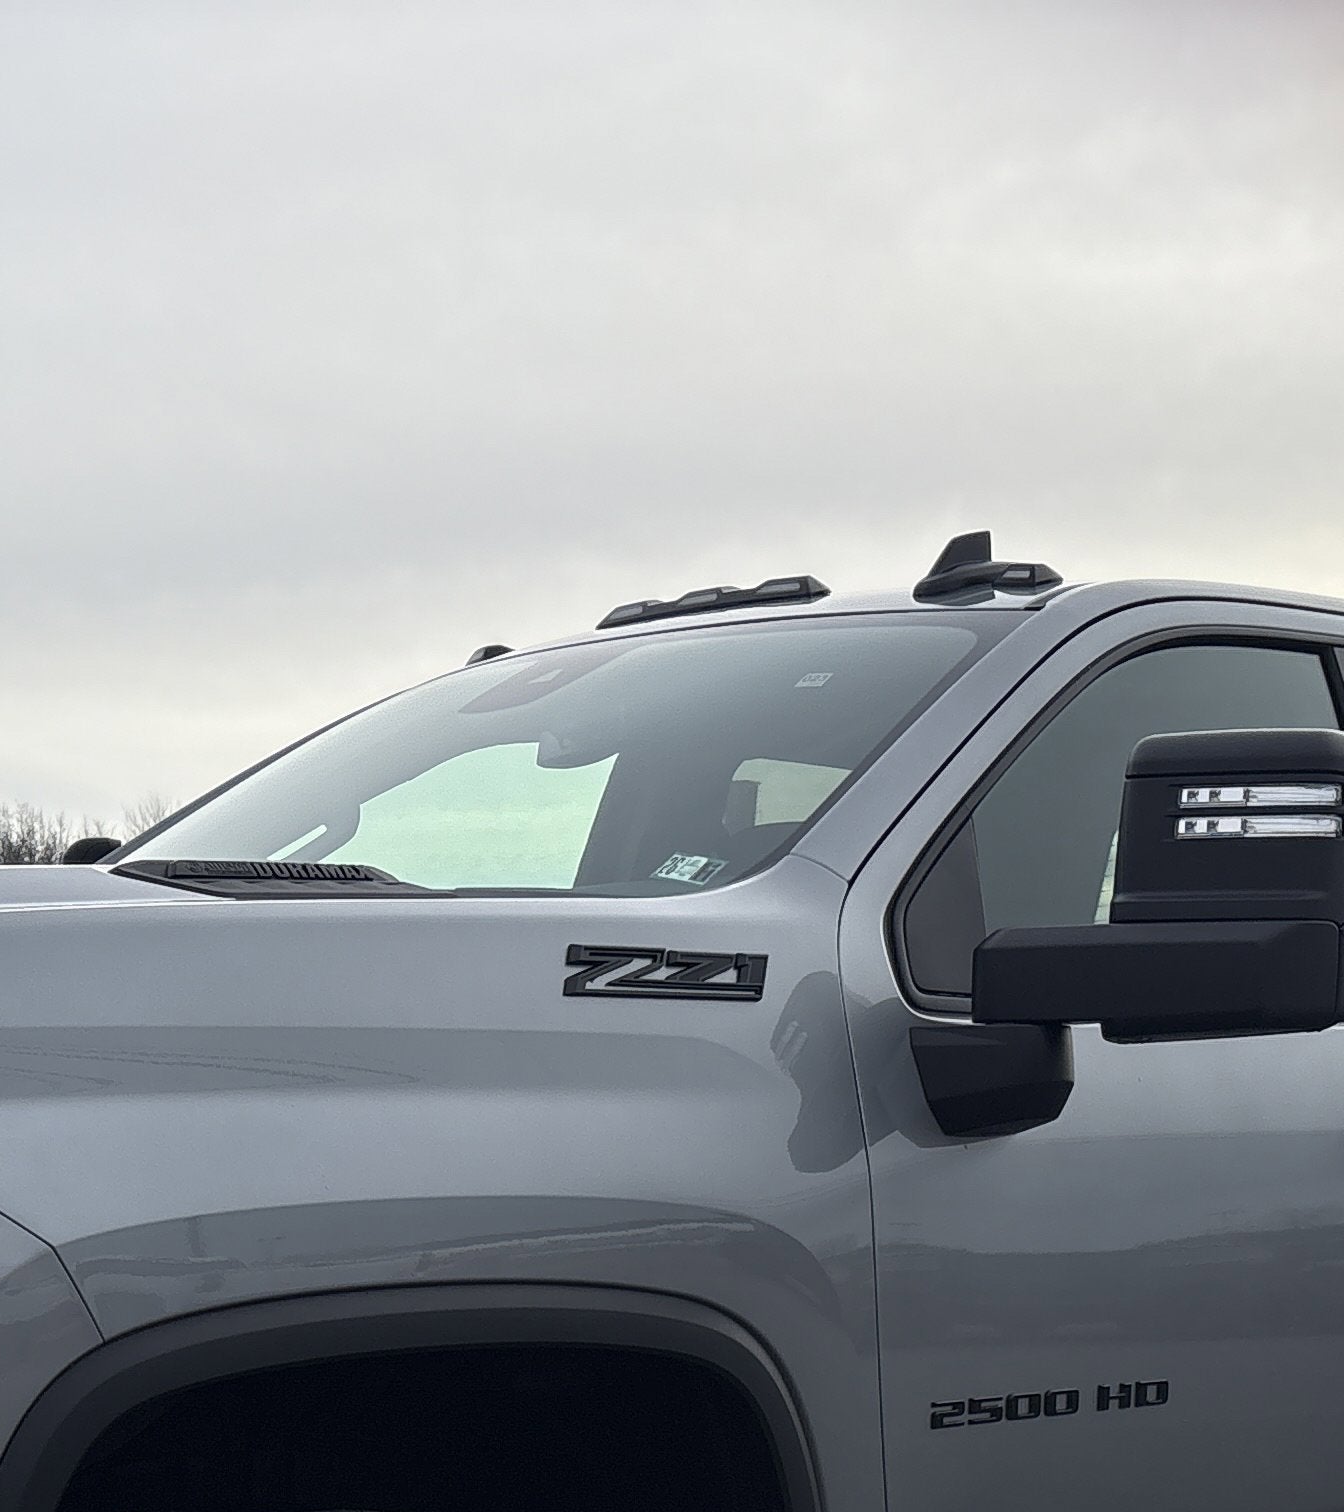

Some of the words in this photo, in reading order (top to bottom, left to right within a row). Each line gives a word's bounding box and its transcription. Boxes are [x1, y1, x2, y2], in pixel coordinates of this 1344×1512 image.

[253, 861, 372, 880] DURAMAX
[563, 943, 769, 1002] Z71
[929, 1389, 1080, 1431] 2500
[1095, 1378, 1170, 1412] HD
